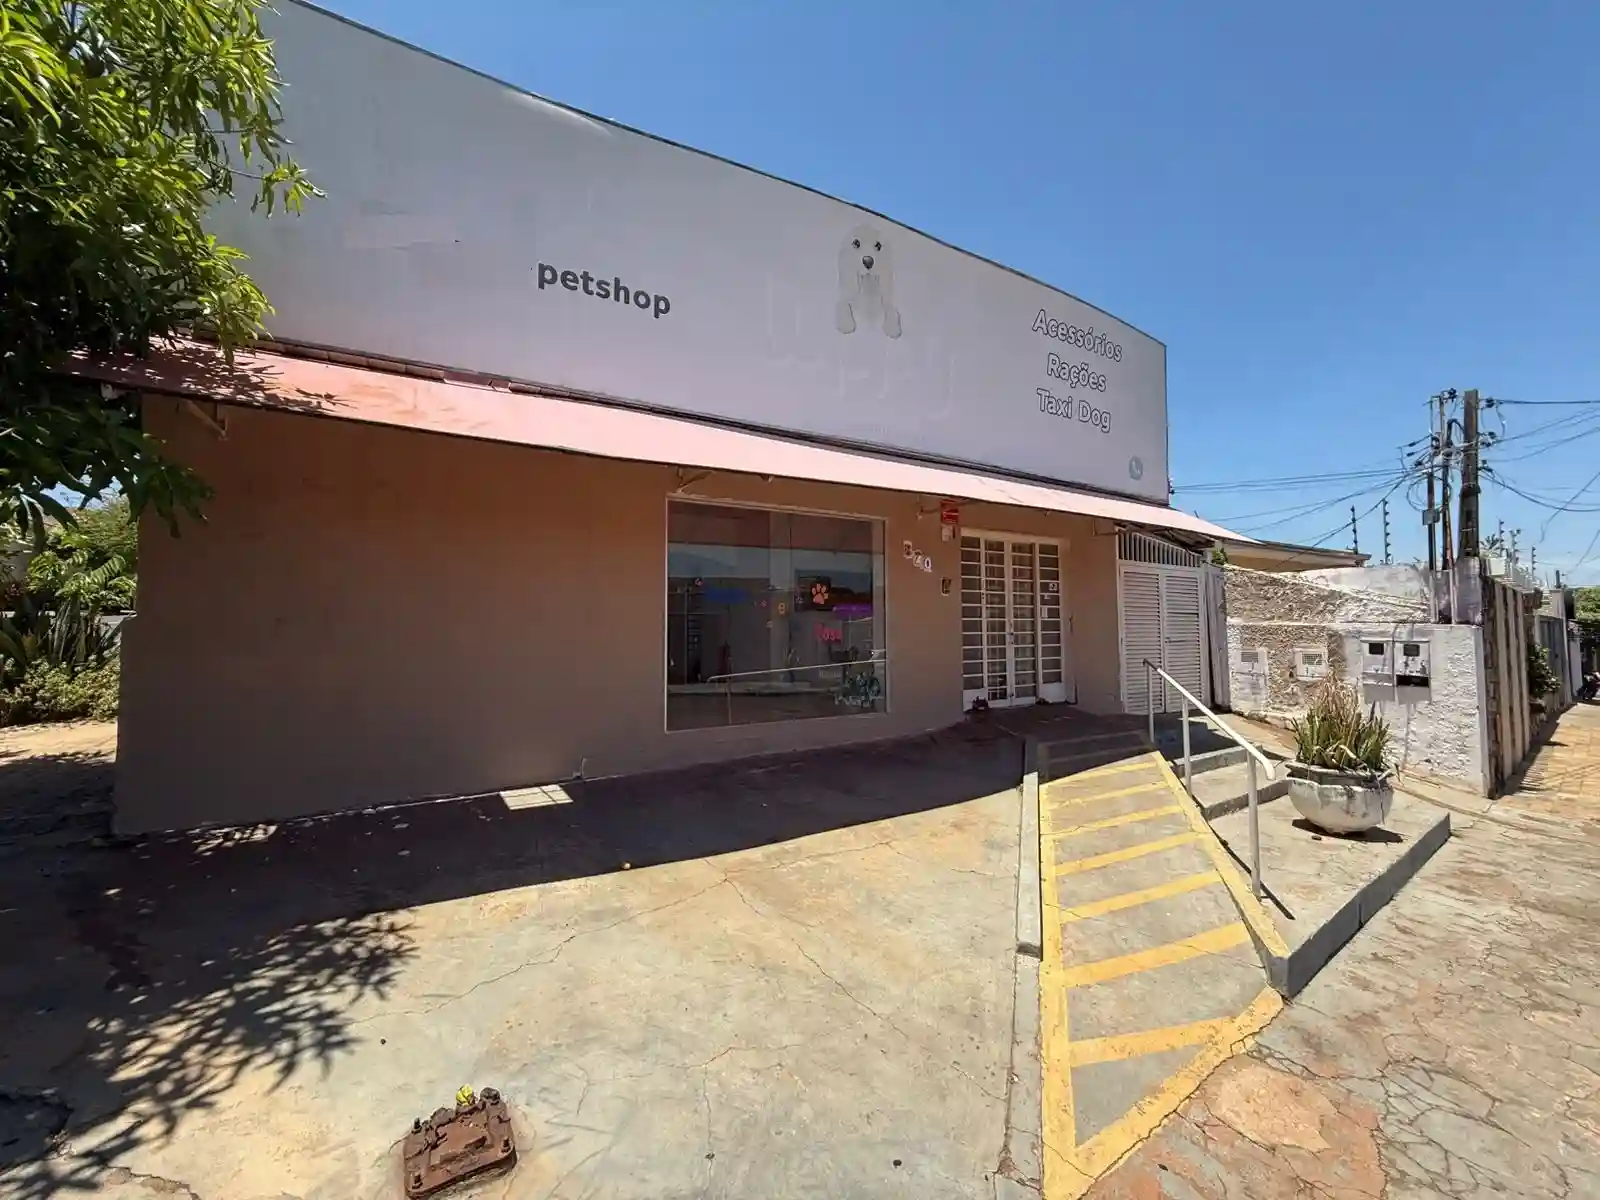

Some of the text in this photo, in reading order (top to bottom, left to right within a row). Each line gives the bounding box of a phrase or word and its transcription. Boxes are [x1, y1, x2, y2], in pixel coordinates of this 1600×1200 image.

[537, 261, 671, 319] petshop
[1032, 308, 1123, 362] Acessórios
[1046, 352, 1107, 392] Rações
[1036, 387, 1112, 433] Taxi Dog
